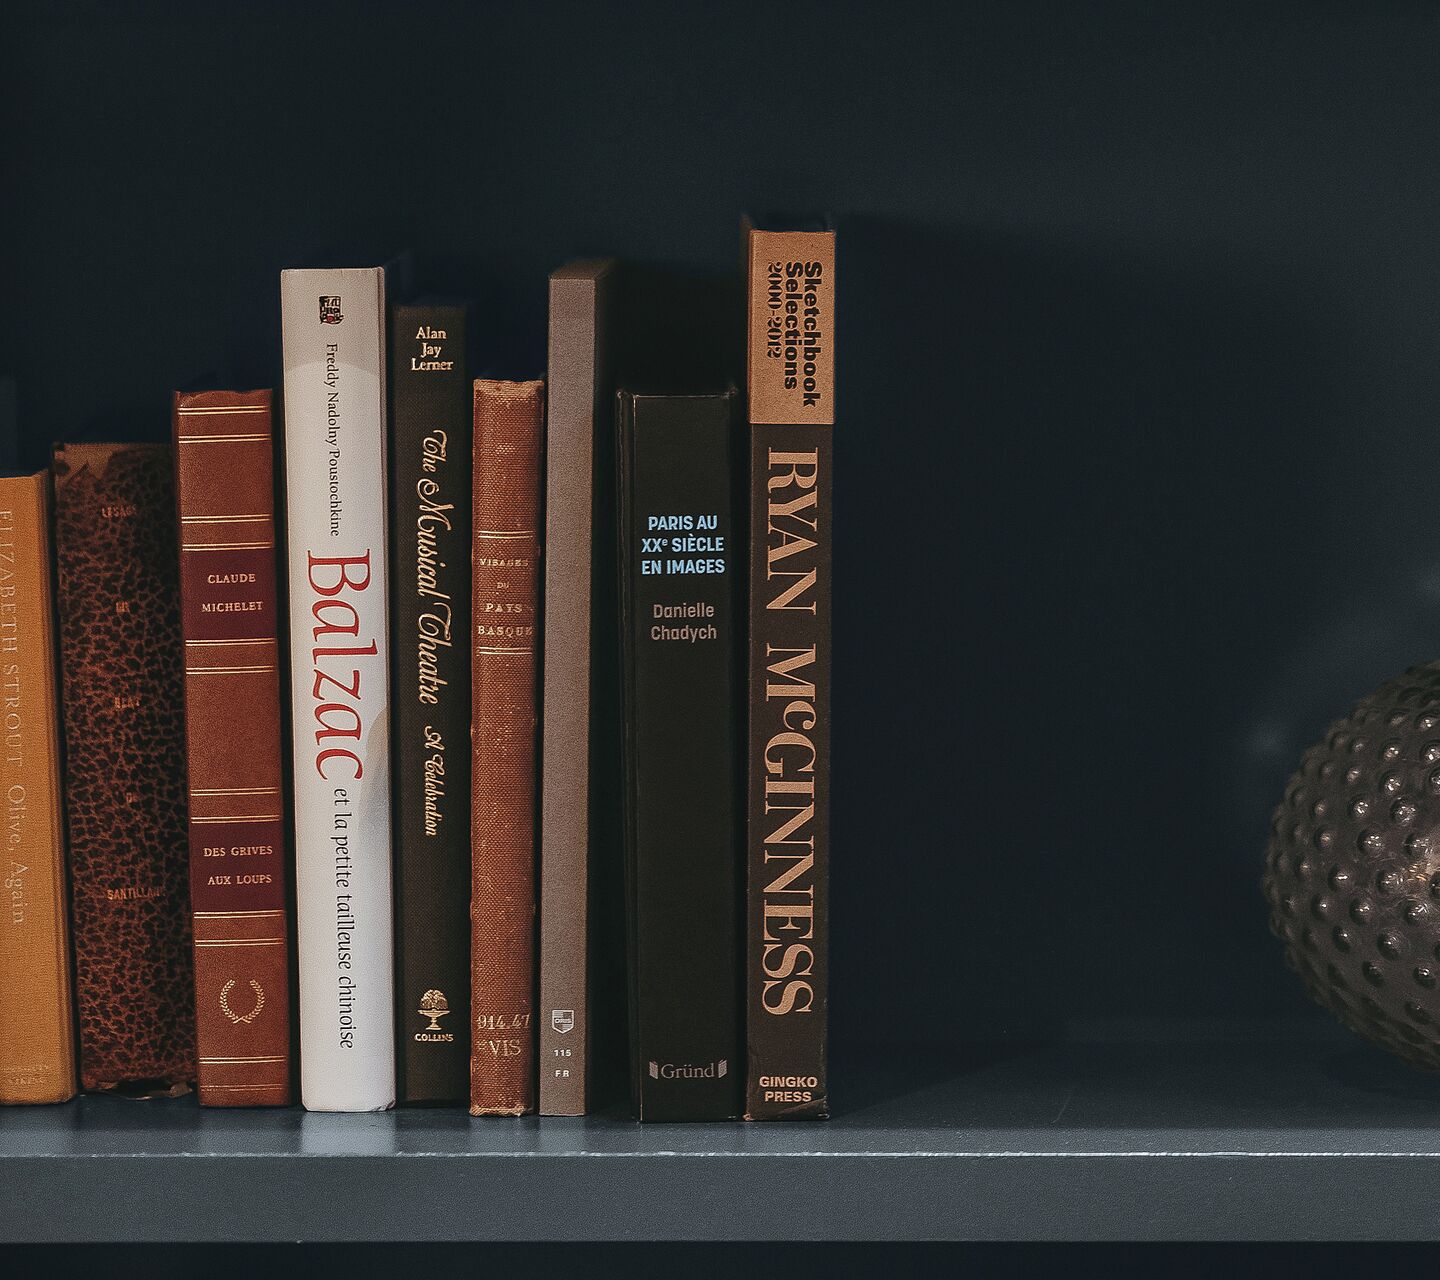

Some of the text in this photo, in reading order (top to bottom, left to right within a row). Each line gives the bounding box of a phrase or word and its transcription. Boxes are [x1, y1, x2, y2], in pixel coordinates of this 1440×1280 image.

[766, 261, 783, 359] 2000-2012
[416, 326, 448, 339] Alan
[784, 261, 803, 390] Selections
[803, 261, 823, 407] Sketchbook
[421, 343, 442, 358] Jay
[324, 343, 339, 388] Freddy
[411, 357, 454, 371] Lerner
[325, 392, 341, 447] Nadolny
[327, 448, 343, 537] Poustochkine
[648, 515, 718, 531] PARIS AU
[671, 533, 724, 552] SIÈCLE
[480, 558, 529, 567] VISAGES
[641, 559, 725, 575] EN IMAGES
[207, 573, 256, 584] CLAUDE
[202, 601, 263, 613] MICHELET
[484, 603, 523, 613] PAYS
[653, 602, 715, 619] Danielle
[416, 429, 455, 837] The Musical Theatre A Celebration
[478, 626, 533, 638] BASQUE
[651, 624, 717, 643] Chadych
[4, 661, 24, 767] STROUT
[760, 446, 819, 1016] RYAN McGINNESS
[307, 547, 378, 1049] Balzac et la petite tailleuse chinoise
[204, 845, 273, 857] DES GRIVES
[207, 873, 272, 886] AUX LOUPS
[5, 862, 30, 925] Again
[414, 1033, 454, 1042] COLLINS
[488, 1039, 522, 1056] VIS
[553, 1049, 572, 1057] 115
[661, 1062, 715, 1078] Gründ
[759, 1076, 818, 1088] GINGKO
[764, 1091, 812, 1103] PRESS
